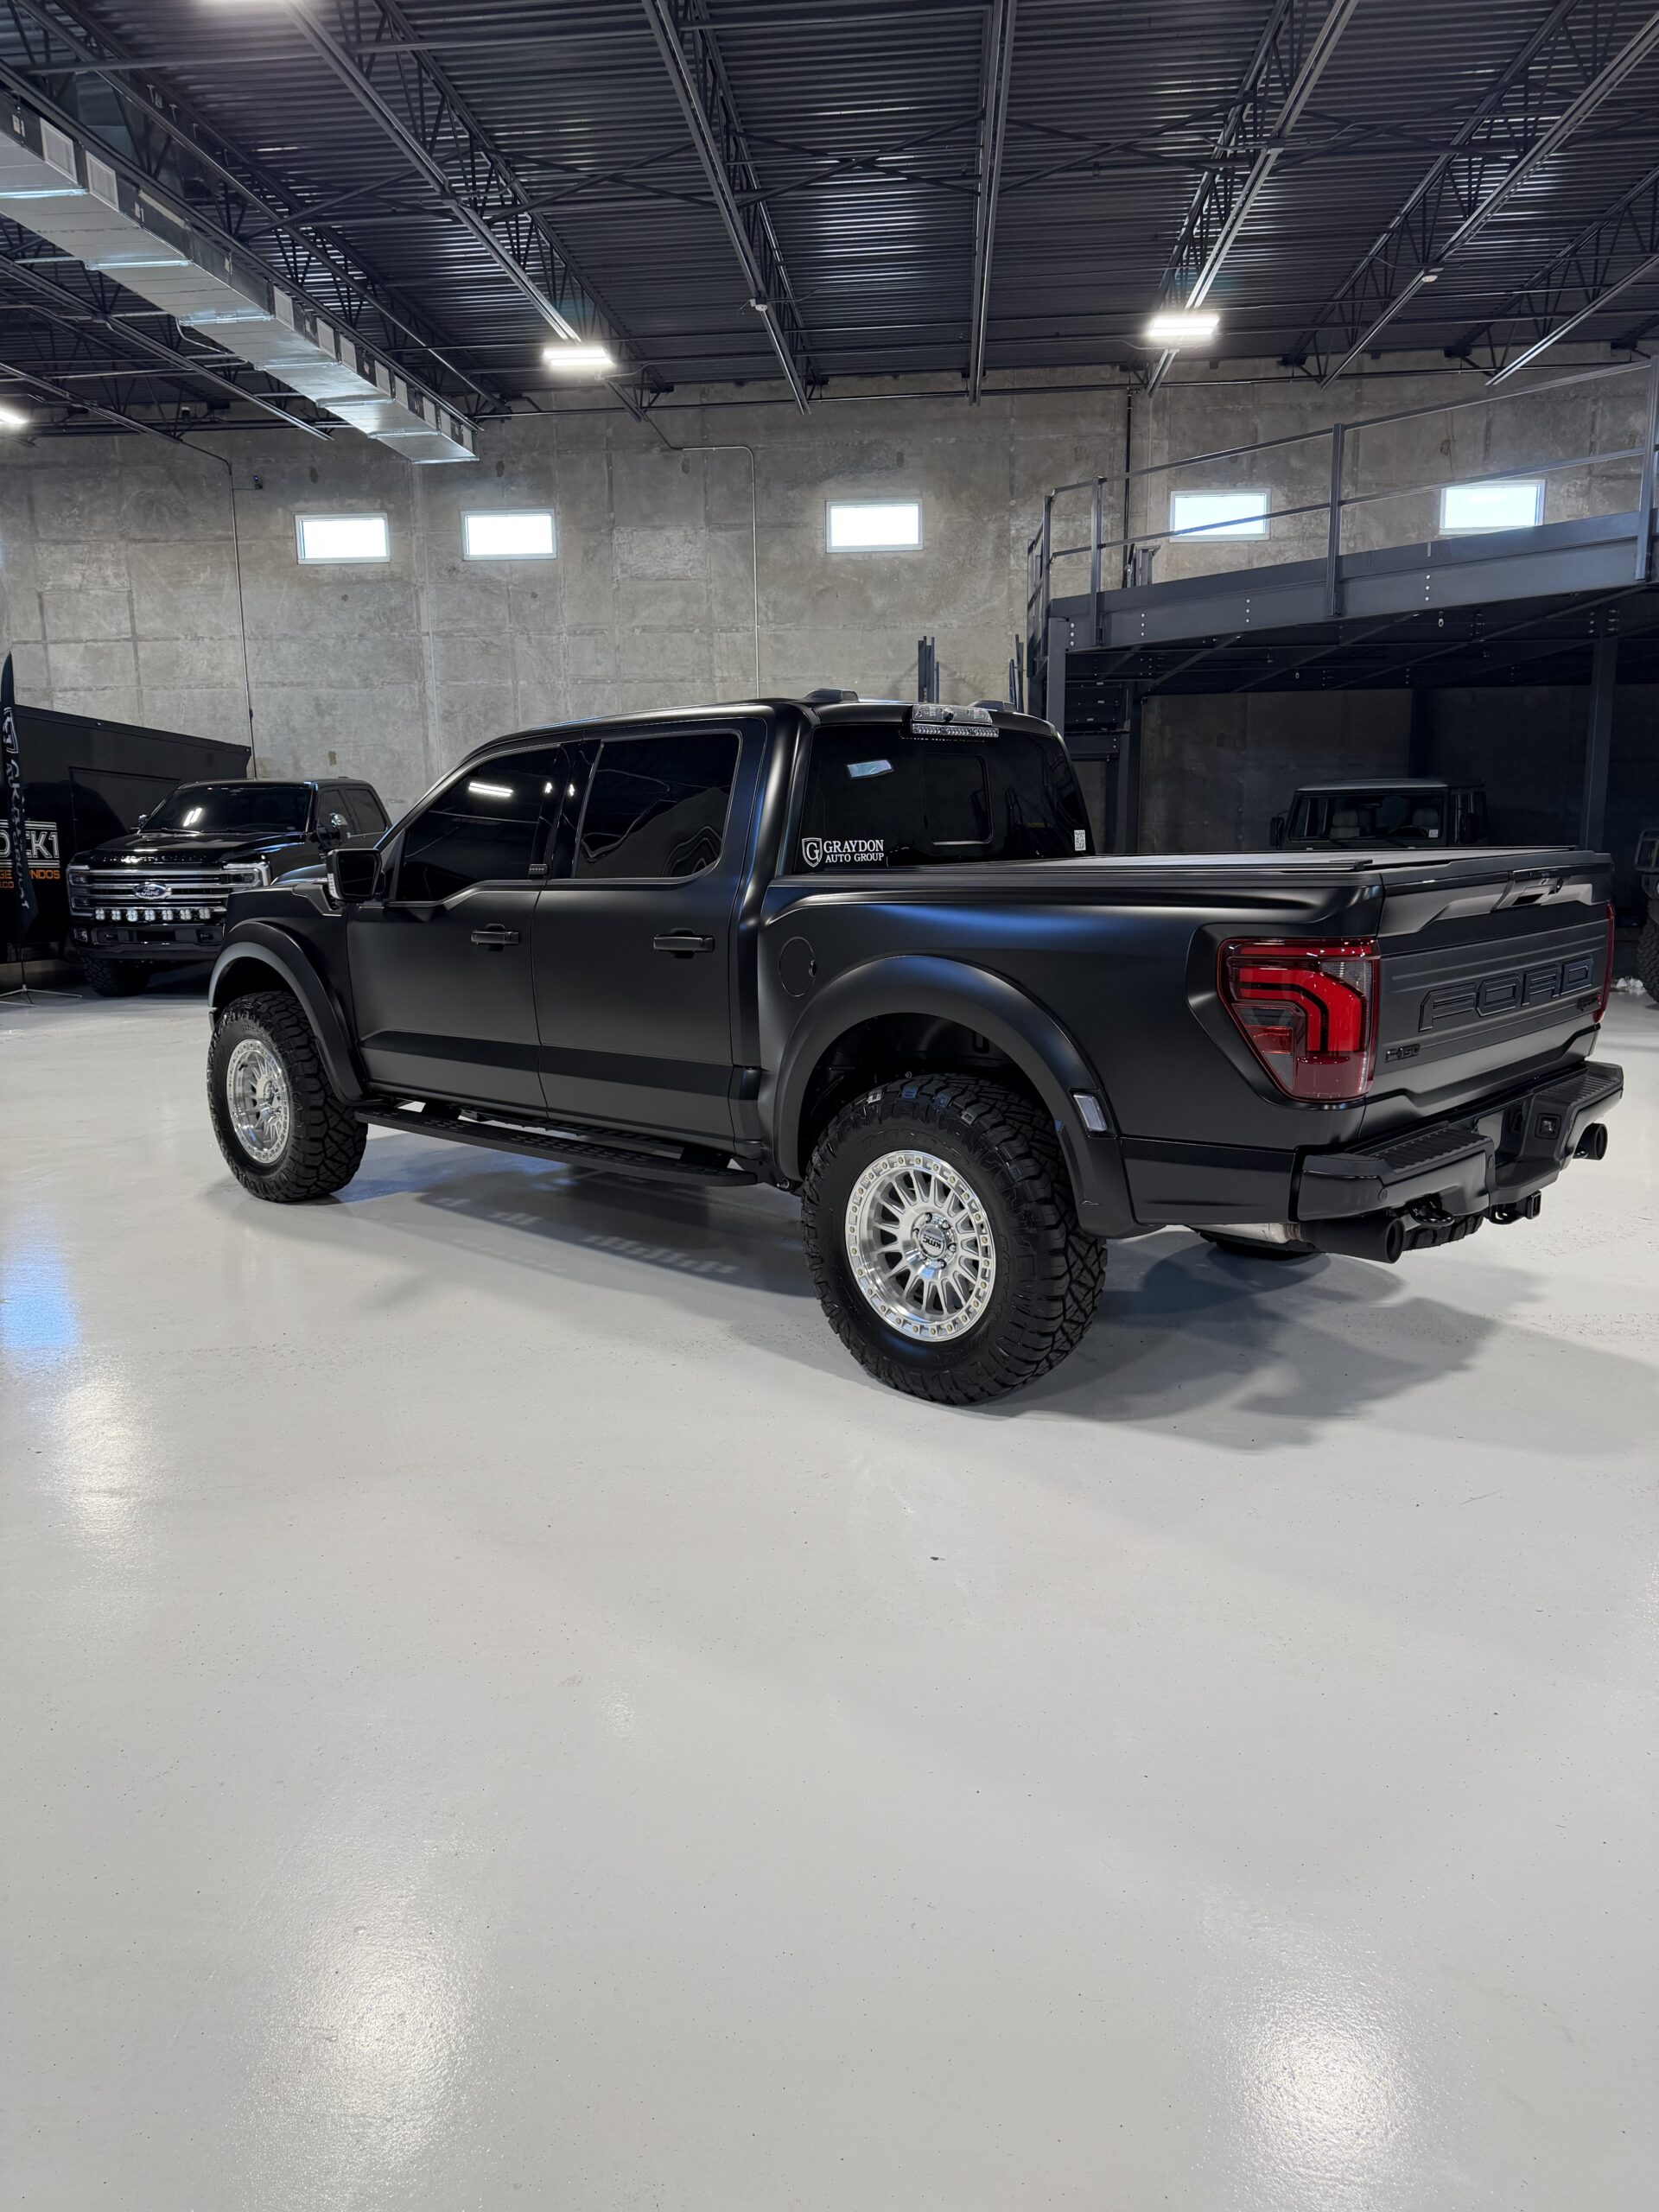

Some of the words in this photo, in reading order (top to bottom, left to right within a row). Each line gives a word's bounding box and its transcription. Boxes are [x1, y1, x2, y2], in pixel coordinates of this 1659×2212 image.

[823, 840, 884, 853] GRAYDON
[825, 854, 851, 863] AUTO
[854, 853, 884, 861] GROUP
[1418, 955, 1593, 1032] FORD
